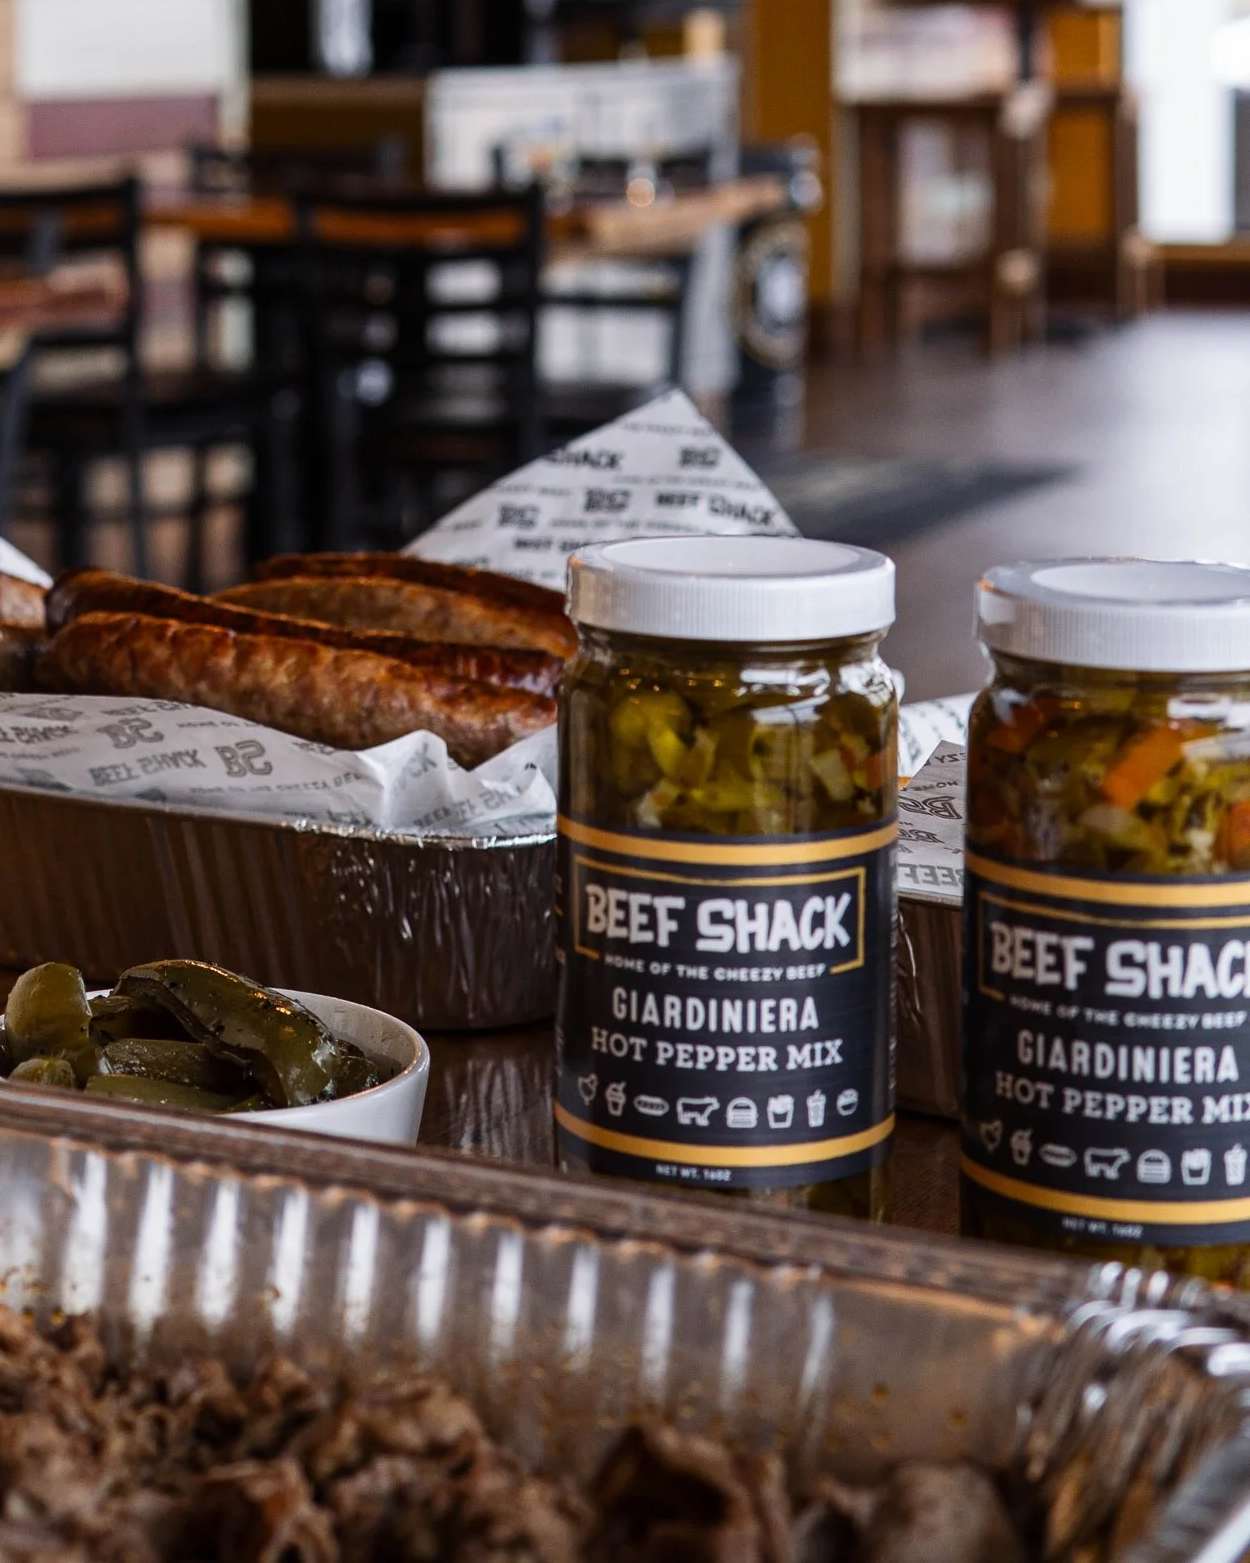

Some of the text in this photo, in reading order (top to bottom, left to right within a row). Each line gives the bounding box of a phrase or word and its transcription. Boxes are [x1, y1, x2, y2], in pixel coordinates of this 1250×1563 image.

[586, 884, 852, 954] BEEF SHACK
[604, 952, 827, 982] HOME OF THE CHEEZY BEEF
[989, 921, 1250, 1000] BEEF SHAC
[611, 986, 820, 1034] GIARDINIERA
[1008, 994, 1248, 1030] HOME OF THE CHEEZY BEEF
[591, 1026, 649, 1062] HOT
[655, 1040, 779, 1073] PEPPER
[785, 1038, 844, 1071] MIX
[1016, 1028, 1240, 1085] GIARDINIERA
[994, 1070, 1055, 1110] HOT
[1061, 1087, 1195, 1126] PEPPER
[655, 1164, 677, 1178] NET
